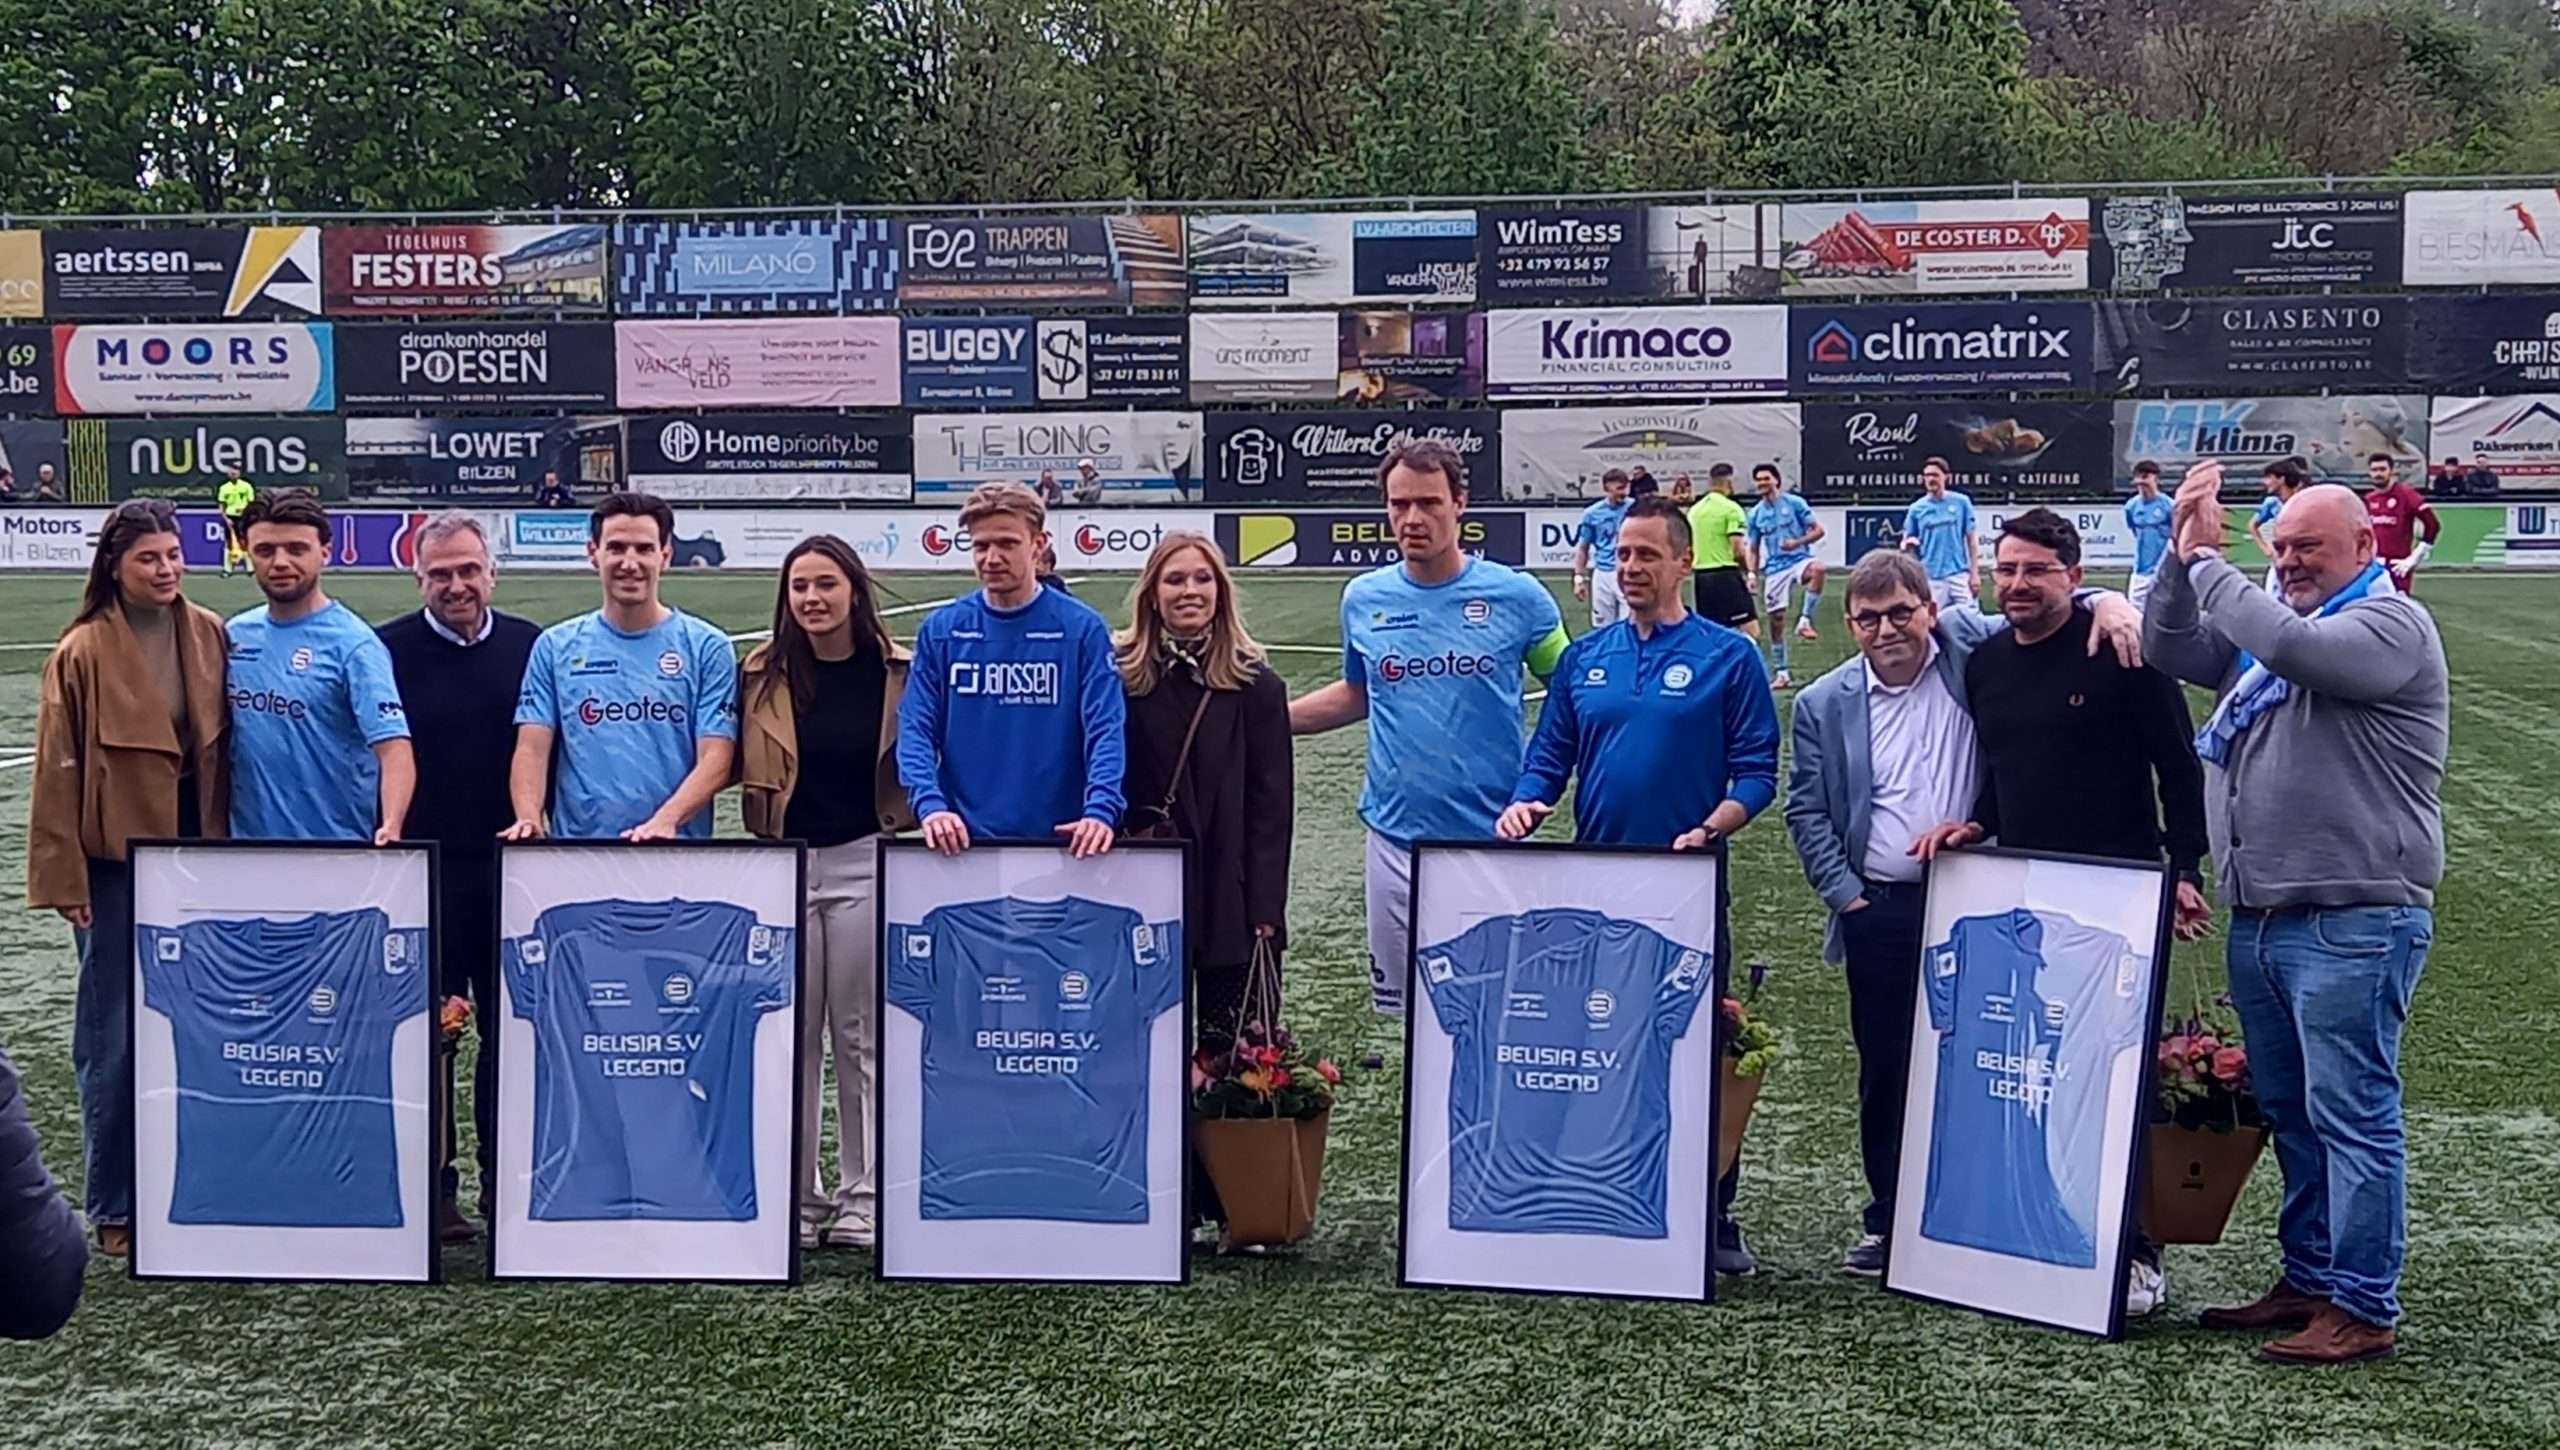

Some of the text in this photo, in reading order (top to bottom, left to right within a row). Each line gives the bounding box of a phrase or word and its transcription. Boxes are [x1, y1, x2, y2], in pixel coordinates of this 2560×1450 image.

[386, 234, 467, 250] TEGELHUIS
[985, 227, 1068, 251] TRAPPEN
[1497, 219, 1622, 243] WimTess
[1895, 228, 2026, 246] DE COSTER D.
[55, 247, 190, 273] aertssen
[352, 254, 503, 287] FESTERS
[1574, 257, 1590, 270] 56
[1593, 257, 1610, 270] 57
[2223, 308, 2380, 330] CLASENTO
[400, 330, 547, 348] drankenhandel
[907, 328, 1026, 360] BUGGY
[1542, 319, 1732, 359] Krimaco
[1863, 315, 2071, 361] climatrix
[7, 345, 36, 366] 69
[97, 337, 288, 366] MOORS
[401, 349, 547, 383] POESEN
[1542, 360, 1732, 374] FINANCIAL CONSULTING
[1018, 424, 1110, 456] ICING
[1845, 412, 1919, 446] Raoul
[2196, 426, 2295, 454] klima
[131, 427, 319, 474] nulens.
[430, 431, 544, 459] LOWET
[705, 429, 879, 456] Homepriority.be
[2473, 440, 2553, 451] Dakwerken
[459, 465, 516, 480] BILZEN
[4, 517, 82, 534] Motors
[2079, 514, 2102, 529] BV
[28, 543, 81, 560] Bilzen
[1075, 524, 1163, 556] Geot
[1380, 650, 1495, 682] Geotec
[579, 695, 686, 725] Geotec
[604, 1059, 686, 1077] LEGEND
[996, 1056, 1078, 1074] LEGEND
[241, 1068, 323, 1087] LEGEND
[1516, 1072, 1599, 1092] LEGEND
[1989, 1079, 2054, 1105] LEGEND
